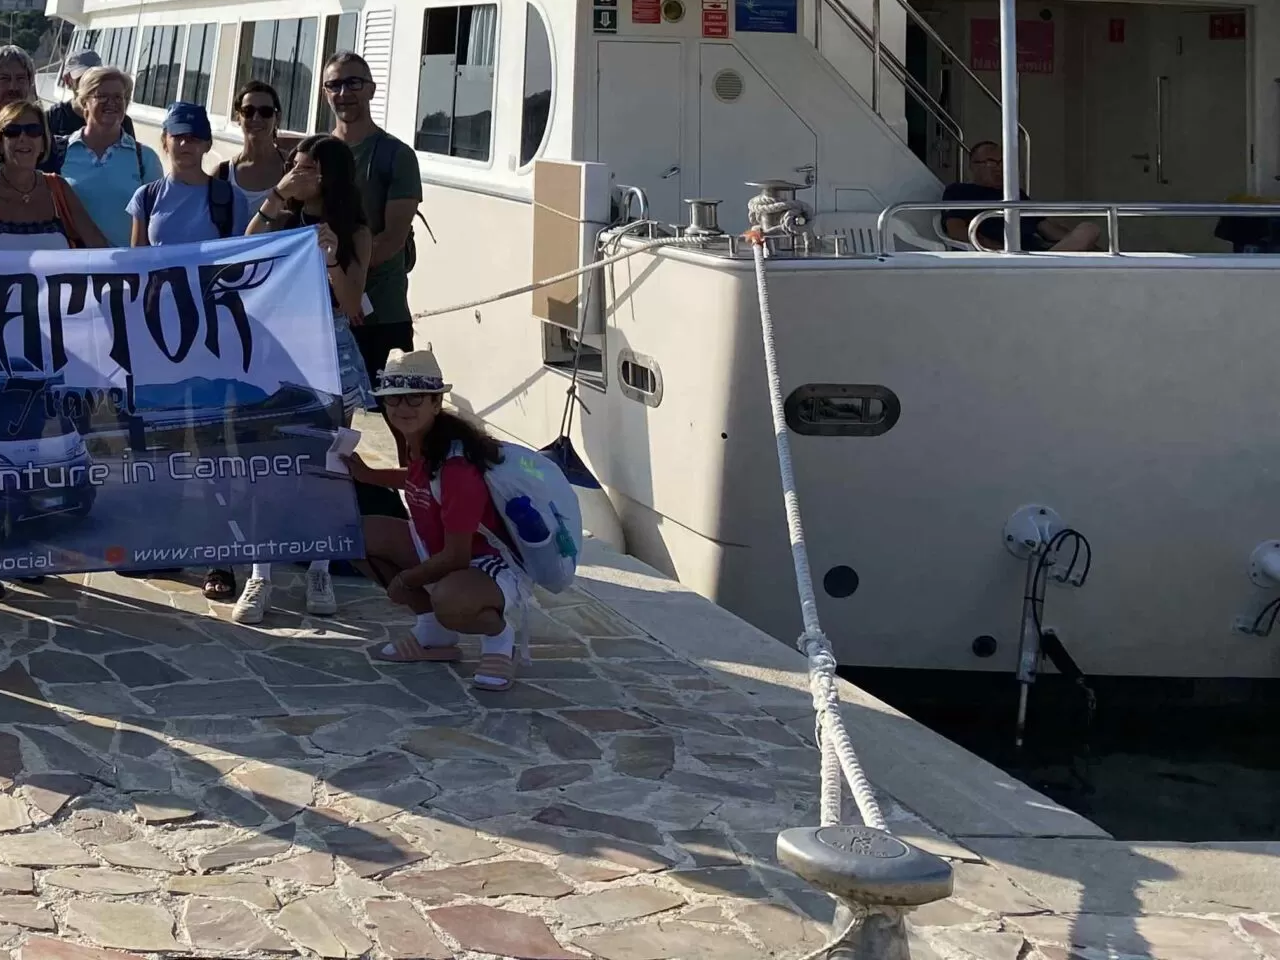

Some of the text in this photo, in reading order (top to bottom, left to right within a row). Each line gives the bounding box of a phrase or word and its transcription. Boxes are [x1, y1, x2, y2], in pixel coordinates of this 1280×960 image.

[3, 374, 137, 436] Travel
[123, 453, 156, 484] in
[168, 451, 311, 483] Camper
[134, 535, 355, 563] www.raptortravel.it
